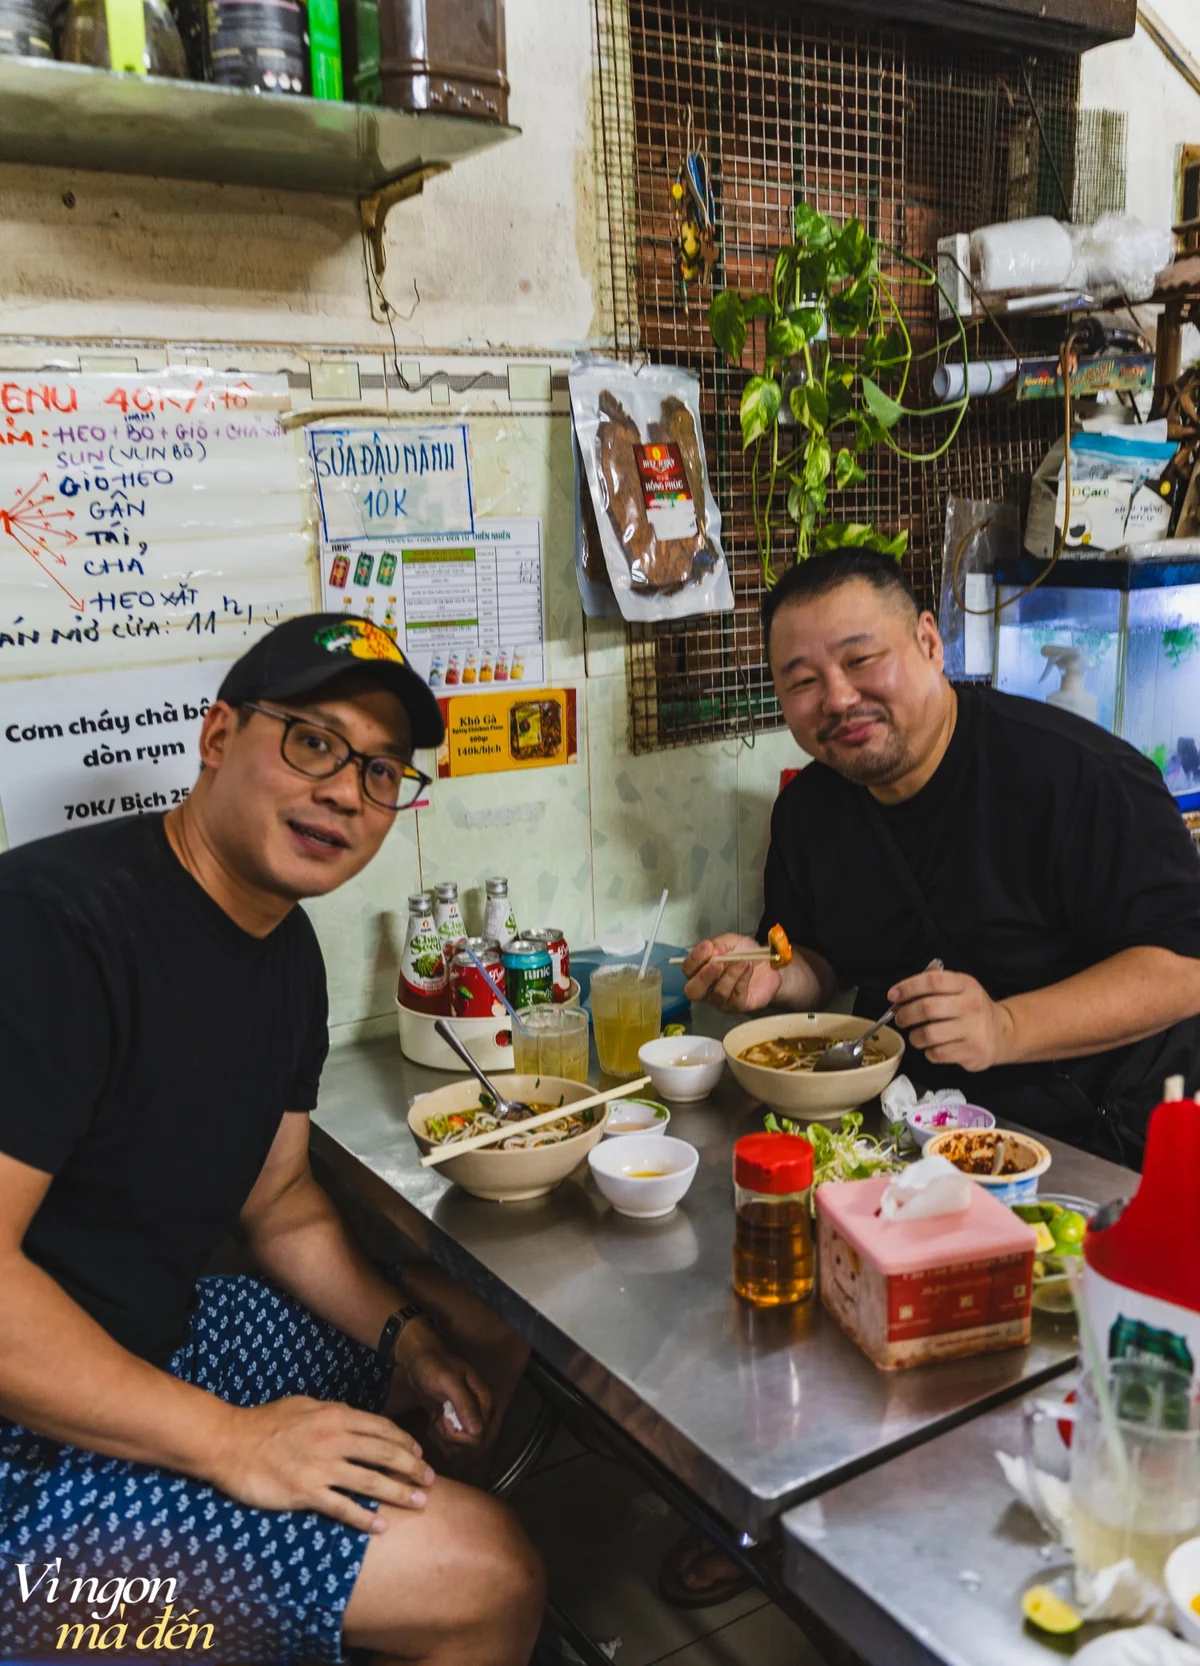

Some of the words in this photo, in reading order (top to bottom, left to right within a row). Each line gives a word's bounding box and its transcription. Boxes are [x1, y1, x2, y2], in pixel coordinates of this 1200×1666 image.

[52, 425, 106, 445] HEO
[83, 542, 149, 576] CHẢ
[89, 591, 155, 613] HEO
[5, 722, 64, 743] Cơm
[68, 708, 130, 734] cháy
[135, 701, 179, 727] chà
[460, 715, 481, 727] Khô
[483, 714, 497, 725] Gà
[83, 743, 132, 768] dòn
[136, 741, 186, 765] rụm
[64, 797, 116, 821] 70K/
[121, 791, 168, 815] Bịch
